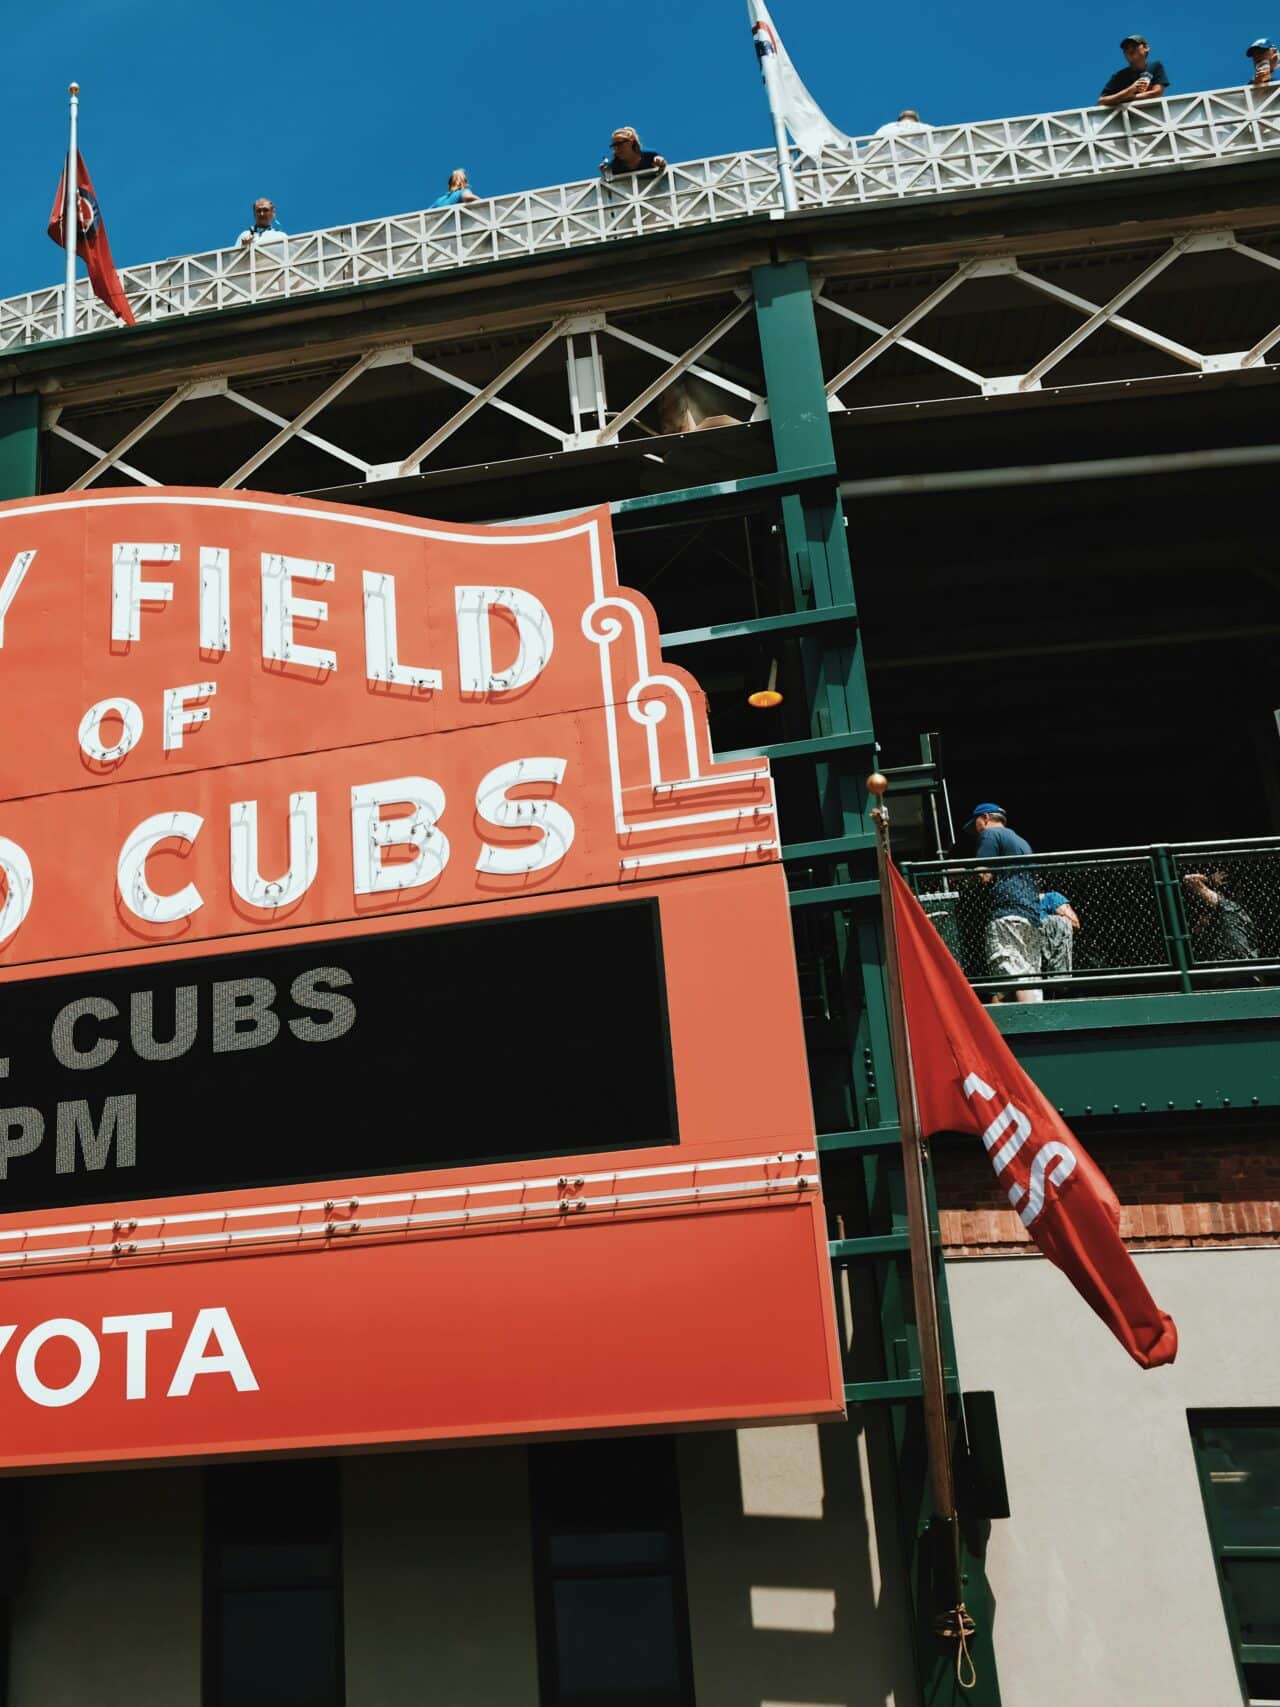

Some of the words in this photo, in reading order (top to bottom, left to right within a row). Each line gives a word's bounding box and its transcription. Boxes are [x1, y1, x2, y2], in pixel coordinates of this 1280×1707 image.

[111, 543, 555, 695] FIELD
[78, 681, 218, 761] OF
[117, 757, 576, 923] CUBS
[51, 966, 358, 1070] CUBS
